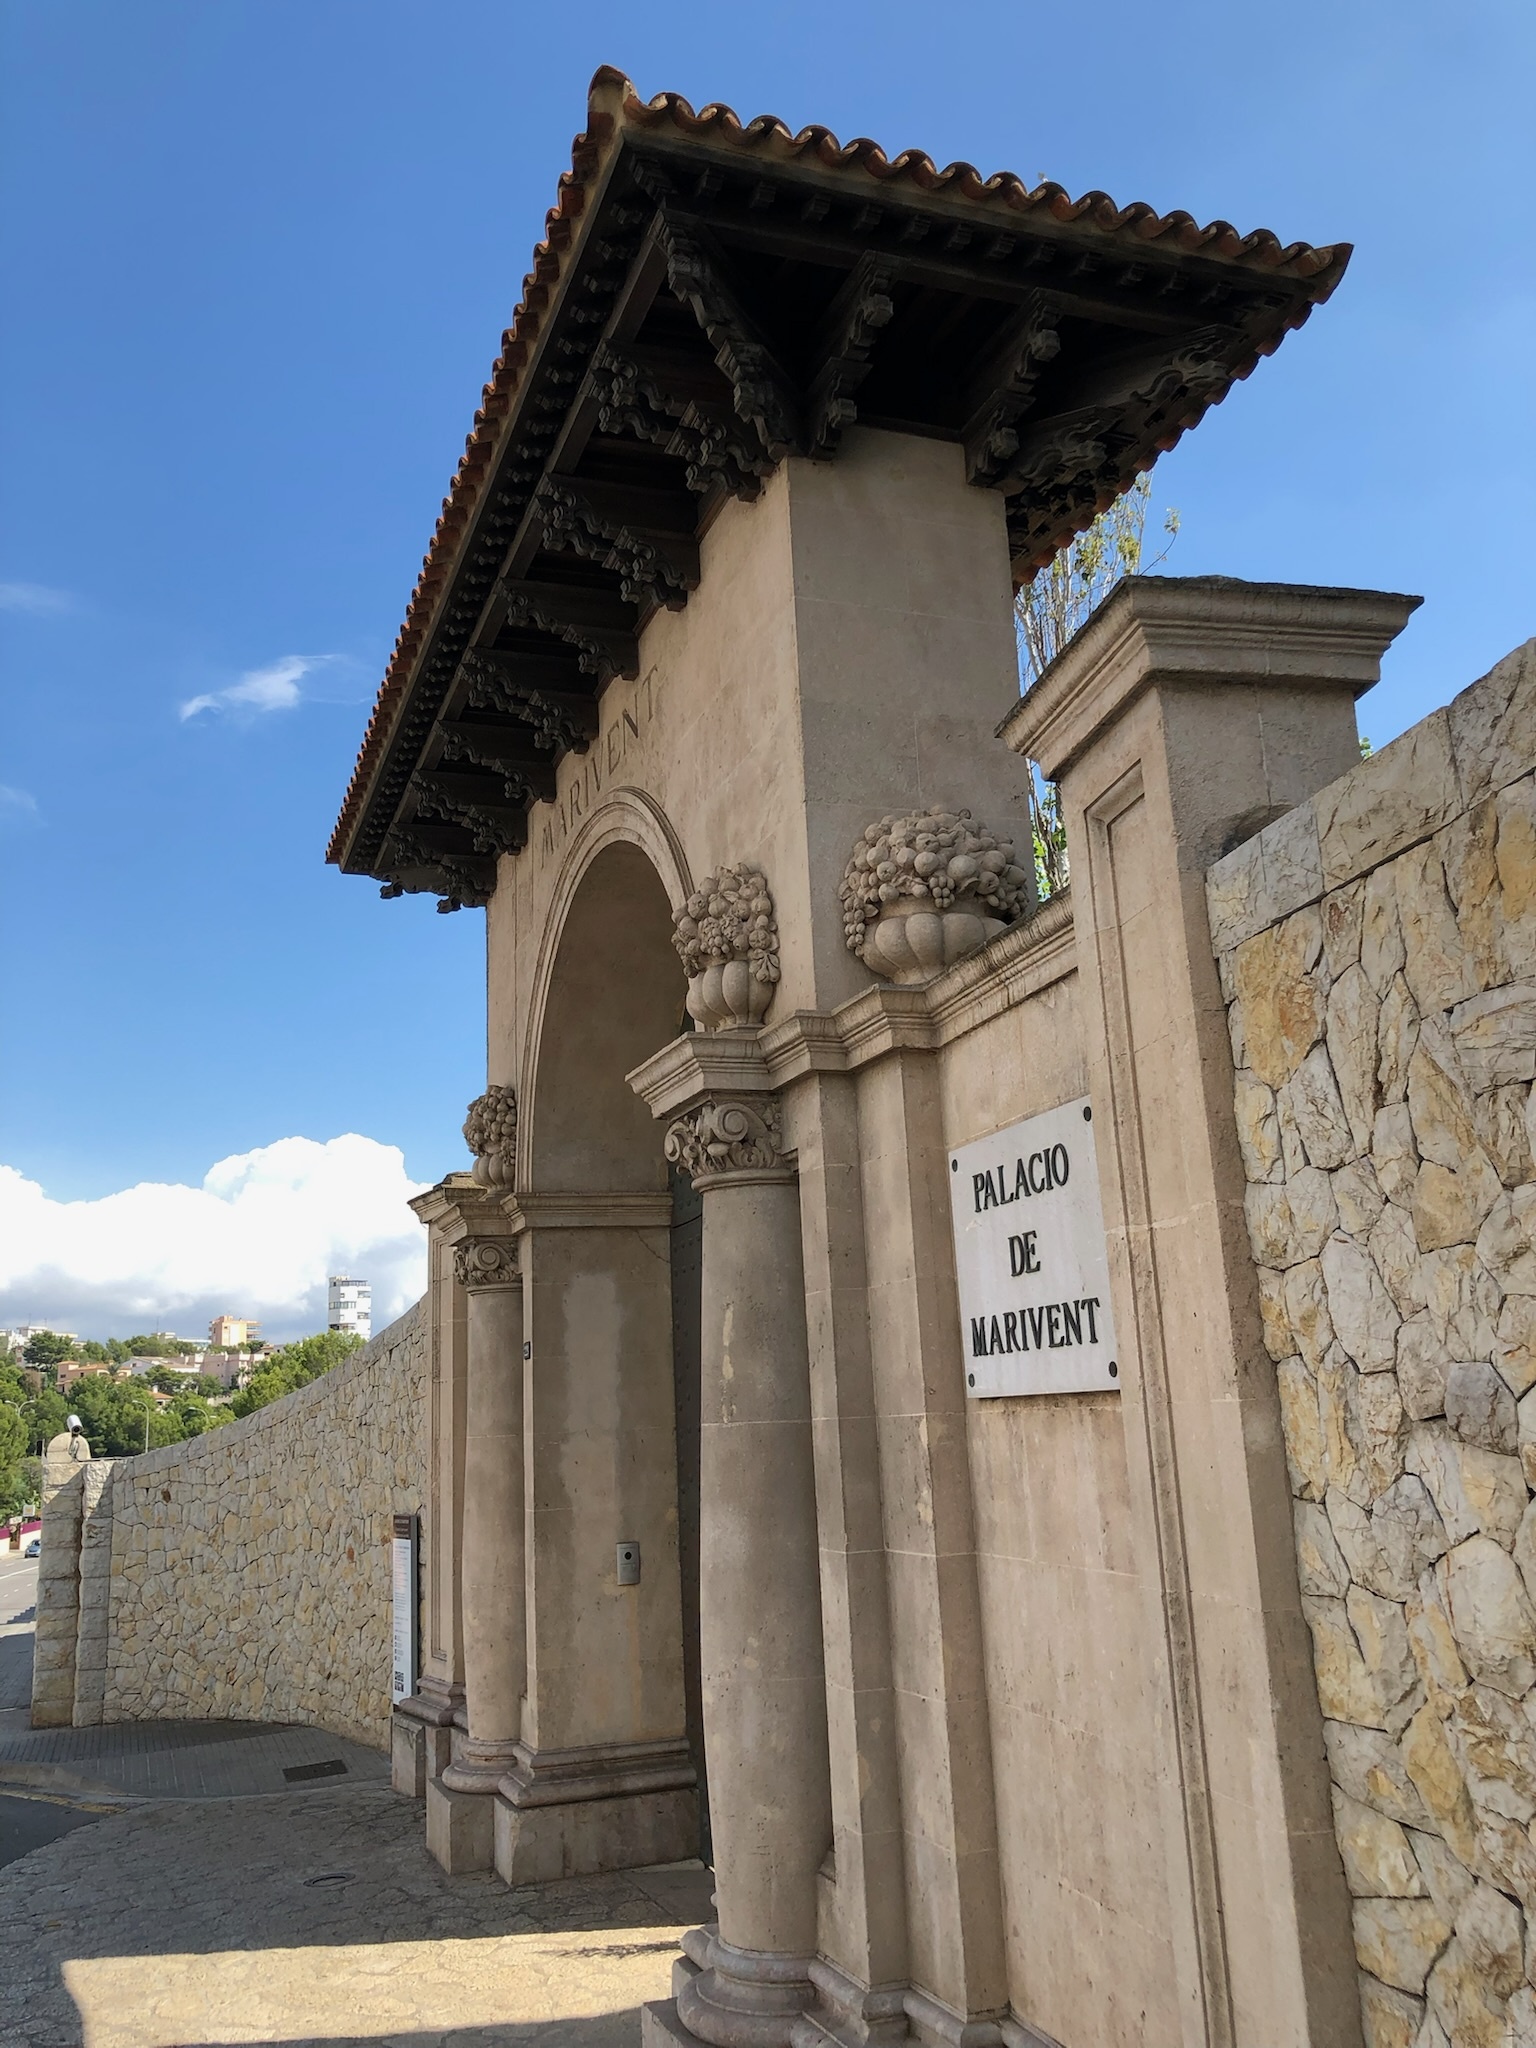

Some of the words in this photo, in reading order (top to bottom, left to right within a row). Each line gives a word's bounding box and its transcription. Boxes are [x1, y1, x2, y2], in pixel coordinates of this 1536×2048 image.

[540, 664, 658, 869] MARIVENT
[972, 1143, 1069, 1213] PALACIO
[1007, 1230, 1041, 1277] DE
[970, 1297, 1100, 1357] MARIVENT
